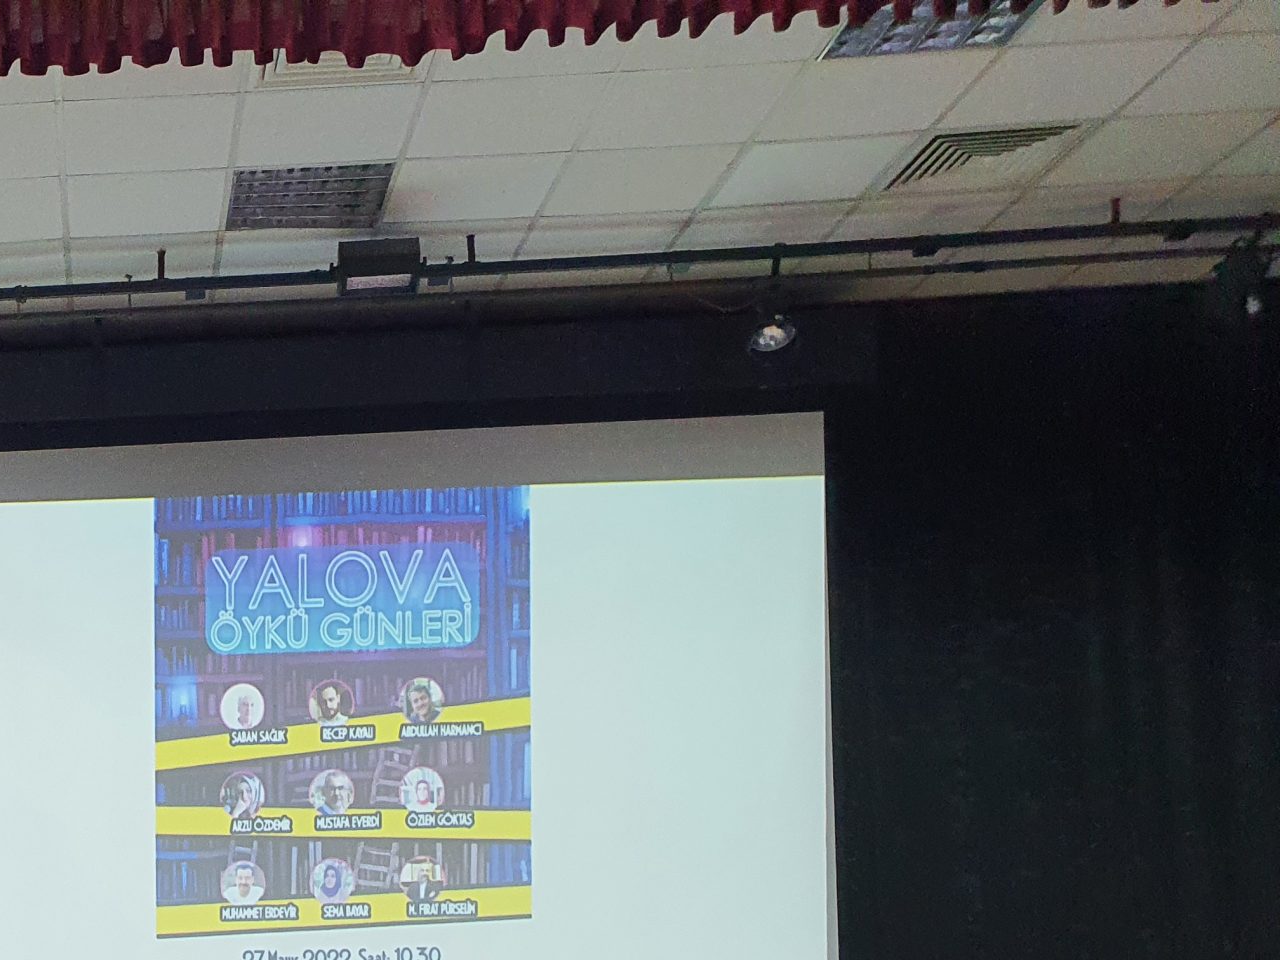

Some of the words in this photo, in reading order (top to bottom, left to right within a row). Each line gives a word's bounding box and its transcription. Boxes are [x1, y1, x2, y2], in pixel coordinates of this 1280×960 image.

[211, 548, 472, 610] YALOVA
[210, 608, 308, 651] ÖYKÜ
[320, 603, 472, 648] GÜNLERİ
